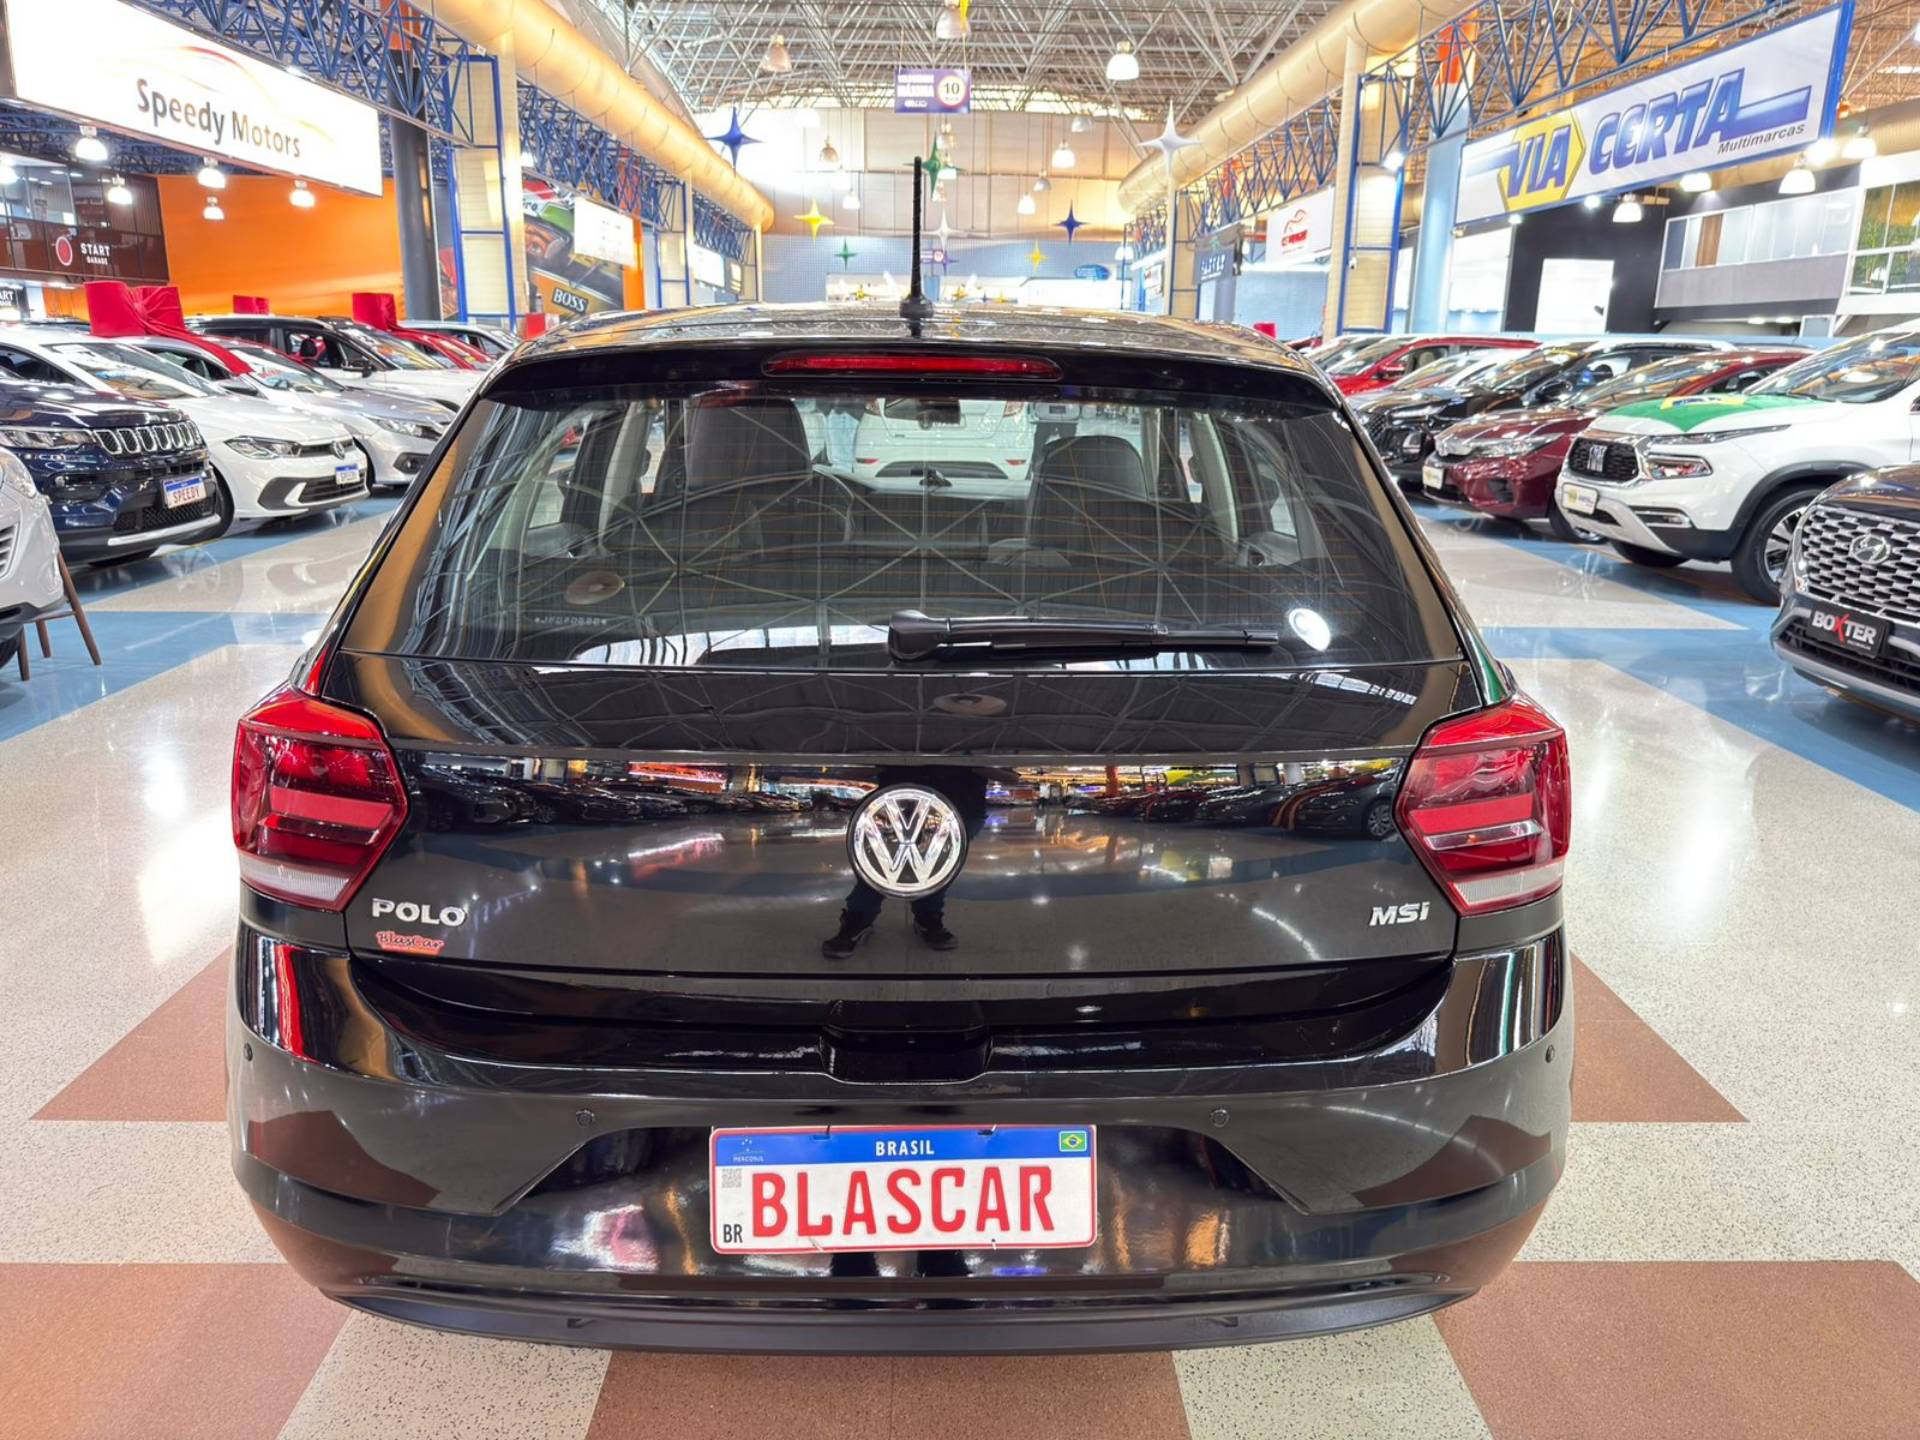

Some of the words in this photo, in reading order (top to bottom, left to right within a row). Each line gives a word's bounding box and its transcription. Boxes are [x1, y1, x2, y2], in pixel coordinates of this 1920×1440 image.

[944, 82, 960, 95] 10
[136, 78, 225, 146] Speedy
[232, 111, 300, 158] Motors
[1717, 123, 1805, 155] Multimarcas
[1506, 123, 1572, 198] VIA
[80, 242, 110, 258] START
[553, 287, 585, 313] BOSS
[173, 486, 200, 504] SPEEDY
[1812, 610, 1877, 647] BOXTER
[372, 898, 466, 927] POLO
[874, 1139, 936, 1157] BRASIL
[752, 1165, 1055, 1239] BLASCAR
[722, 1223, 744, 1244] BR
